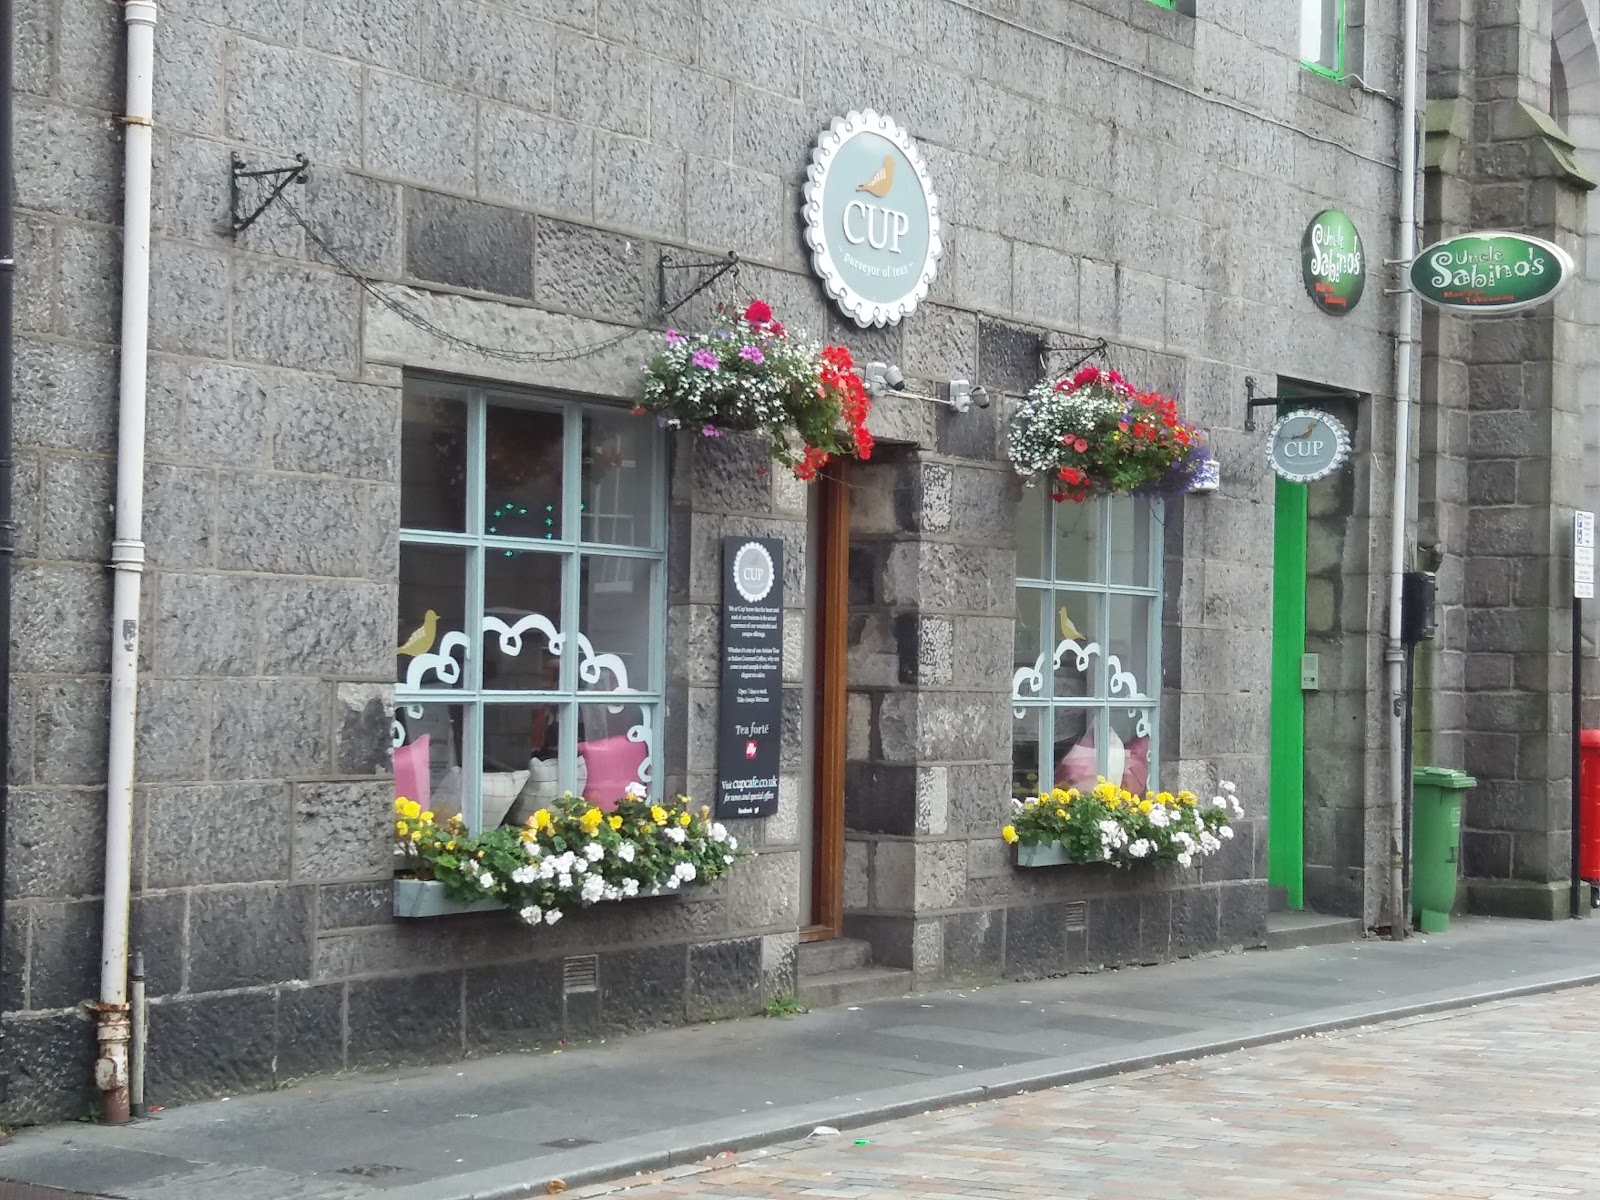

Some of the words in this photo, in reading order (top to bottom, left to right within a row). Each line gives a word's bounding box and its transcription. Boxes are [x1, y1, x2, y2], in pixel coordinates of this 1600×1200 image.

[843, 200, 909, 253] CUP
[1311, 223, 1360, 283] Sabino's
[1455, 246, 1503, 265] Uncle
[844, 252, 879, 276] purveyor
[882, 266, 892, 278] of
[892, 265, 908, 277] teas
[1430, 247, 1545, 288] Sabino's
[1284, 440, 1323, 457] CUP
[743, 567, 764, 581] CUP
[735, 724, 749, 735] Tea
[732, 775, 778, 792] cupcafe.co.uk
